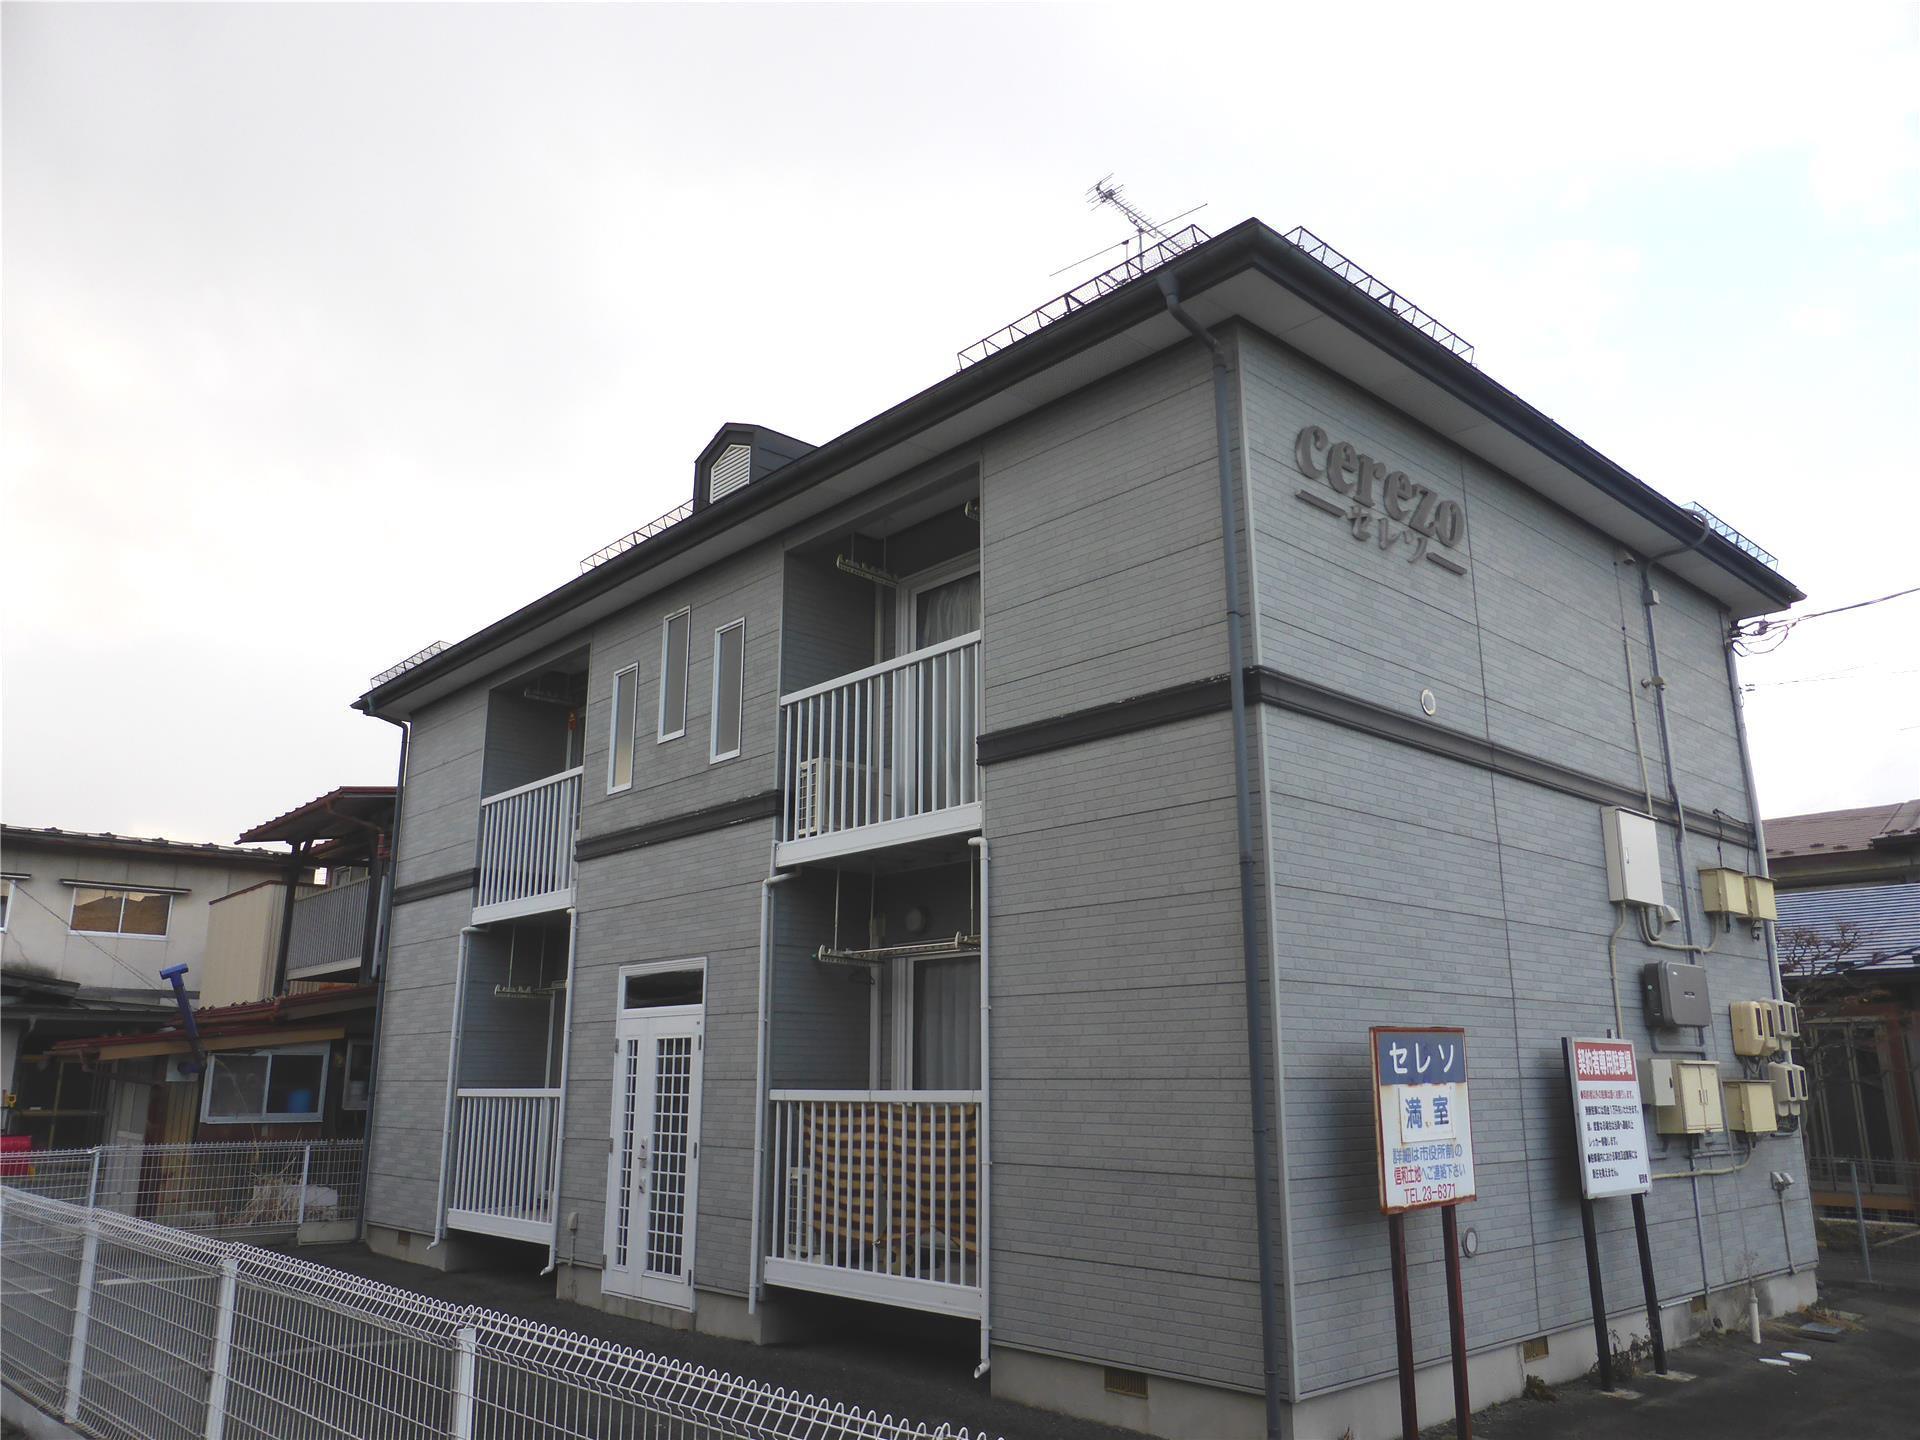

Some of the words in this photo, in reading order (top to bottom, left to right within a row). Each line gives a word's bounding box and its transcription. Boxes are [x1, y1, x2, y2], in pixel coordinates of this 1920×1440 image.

[1389, 1042, 1454, 1074] セレソ
[1577, 1048, 1633, 1076] 契約者専用駐車場
[1392, 1144, 1463, 1164] 詳細は市役所前の
[1404, 1188, 1421, 1204] TEL
[1422, 1183, 1456, 1202] 23-6371
